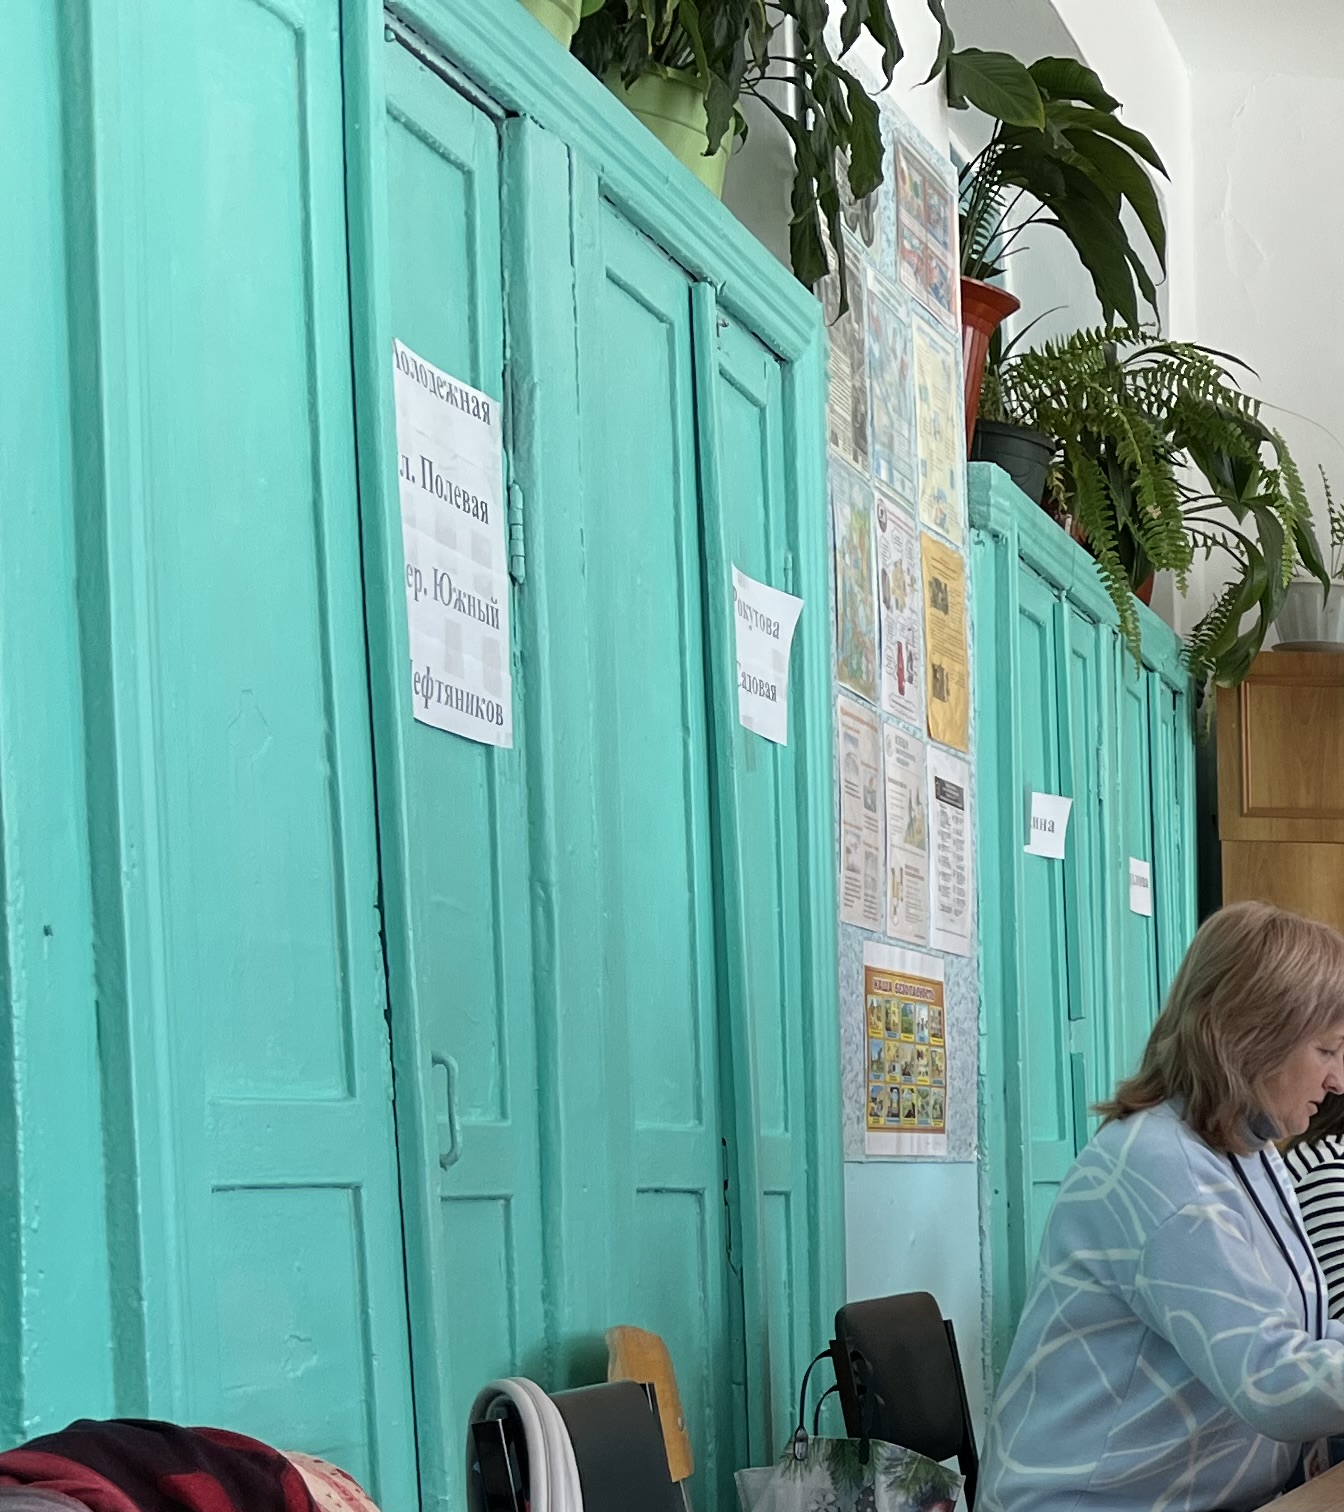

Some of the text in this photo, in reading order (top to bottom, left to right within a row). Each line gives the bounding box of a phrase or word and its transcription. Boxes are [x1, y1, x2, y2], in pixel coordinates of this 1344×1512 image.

[399, 454, 489, 525] л. Полевая
[406, 563, 500, 630] ер. Южный
[411, 658, 504, 726] ефтяников
